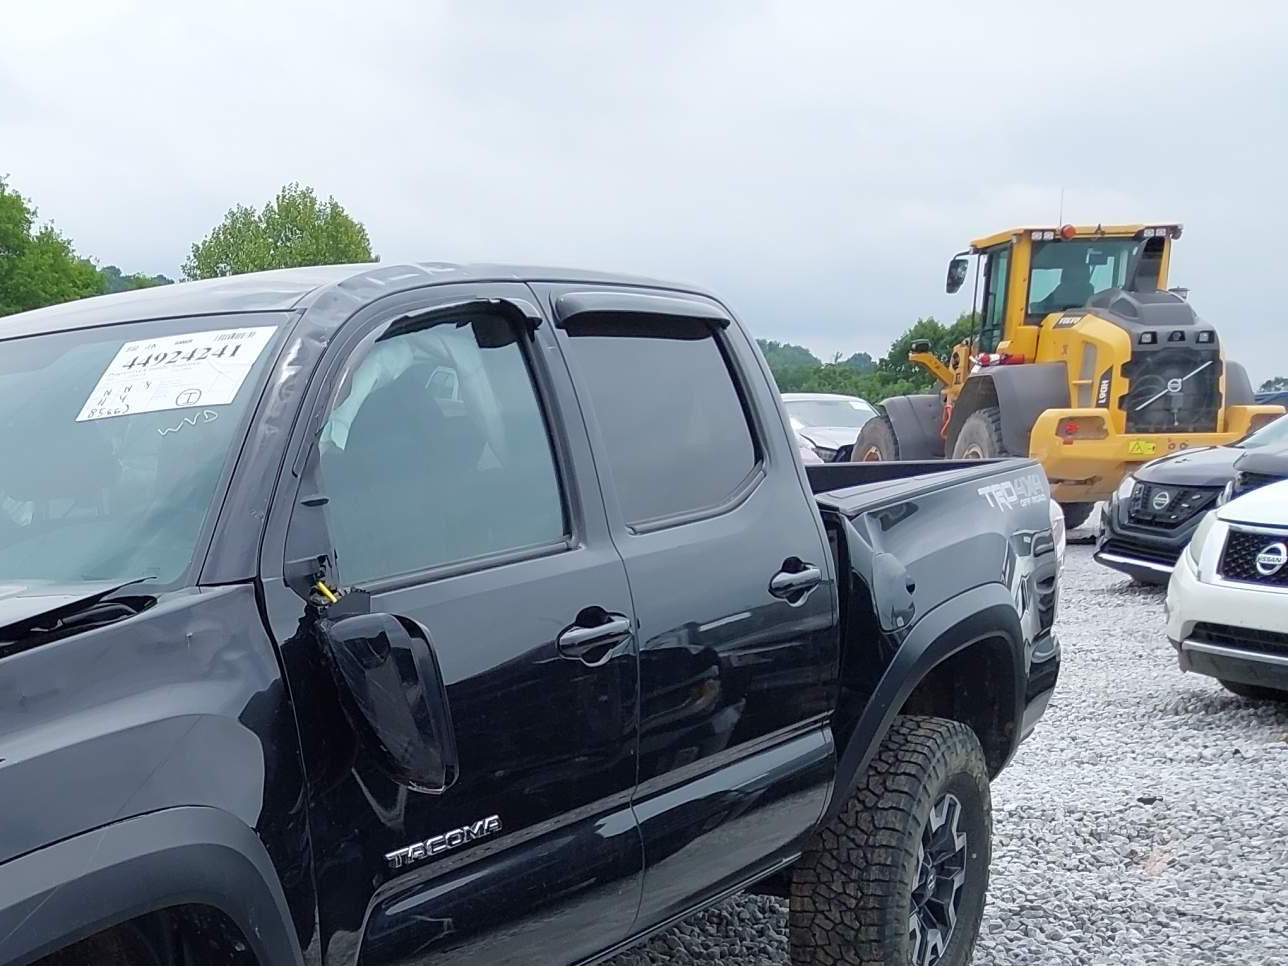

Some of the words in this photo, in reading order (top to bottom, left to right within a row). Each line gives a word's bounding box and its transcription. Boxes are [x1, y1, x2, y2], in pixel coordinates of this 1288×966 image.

[123, 344, 242, 370] 44924241
[977, 481, 1017, 512] TRD
[385, 814, 502, 868] TACOMA
